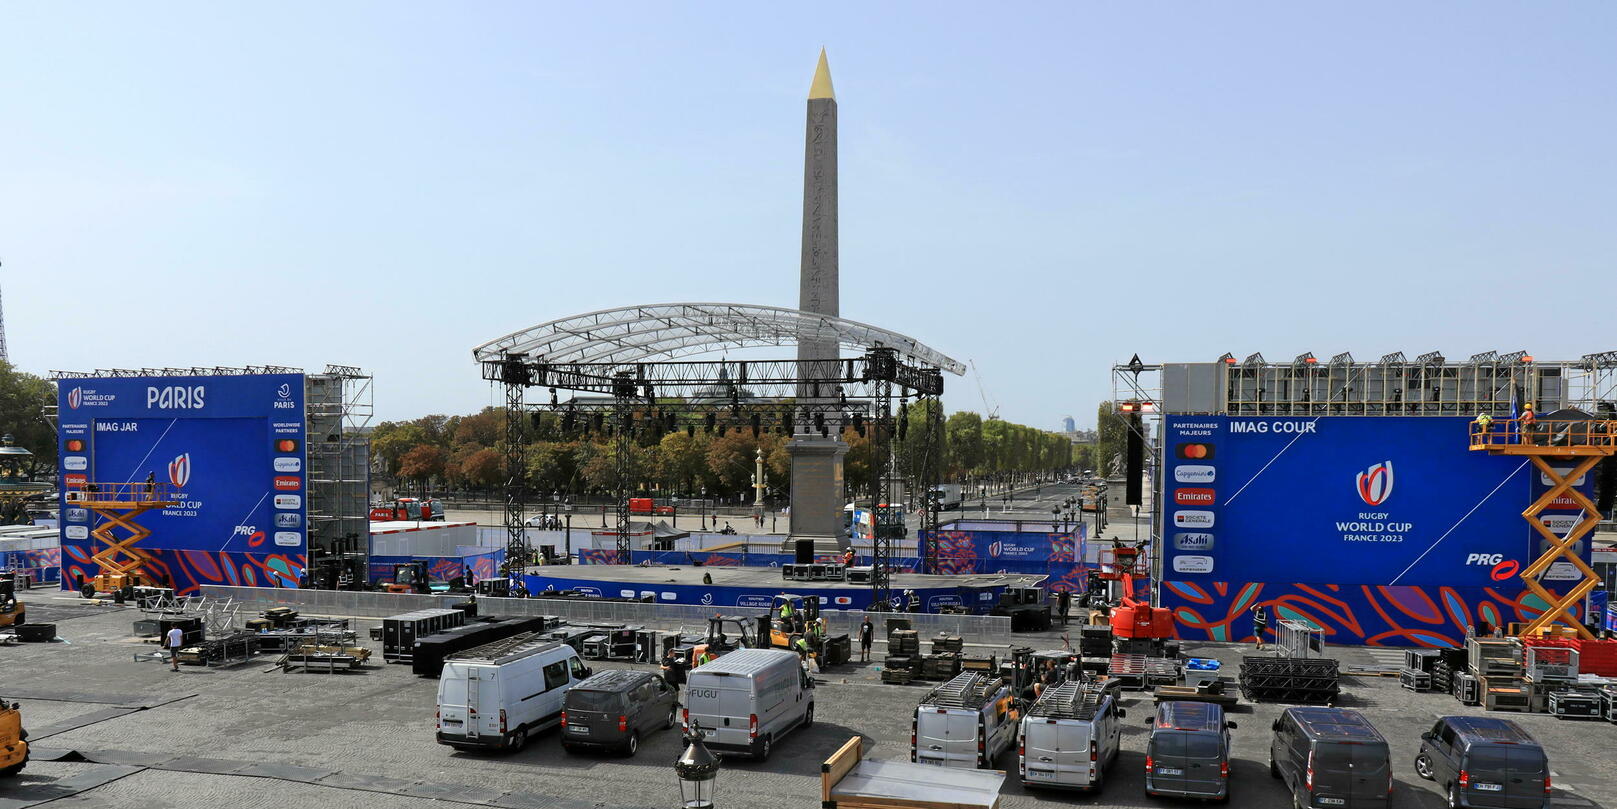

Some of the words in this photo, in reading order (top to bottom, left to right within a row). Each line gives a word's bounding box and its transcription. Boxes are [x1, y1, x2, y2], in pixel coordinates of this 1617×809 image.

[147, 386, 205, 409] PARIS
[273, 401, 295, 409] PARIS
[96, 422, 119, 432] IMAG
[120, 422, 138, 432] JAR
[1230, 421, 1268, 433] IMAG
[1272, 421, 1317, 433] COUR
[1176, 469, 1207, 479] Capgemini
[1177, 492, 1212, 500] Emirates
[186, 501, 202, 509] CUP
[1358, 512, 1389, 520] RUGBY
[233, 526, 256, 536] PRG
[1335, 522, 1385, 532] WORLD
[1386, 522, 1413, 532] CUP
[1180, 534, 1208, 545] Asahi
[1343, 534, 1378, 542] FRANCE
[1379, 535, 1404, 543] 2023
[1465, 553, 1503, 565] PRG
[691, 689, 717, 698] FUGU
